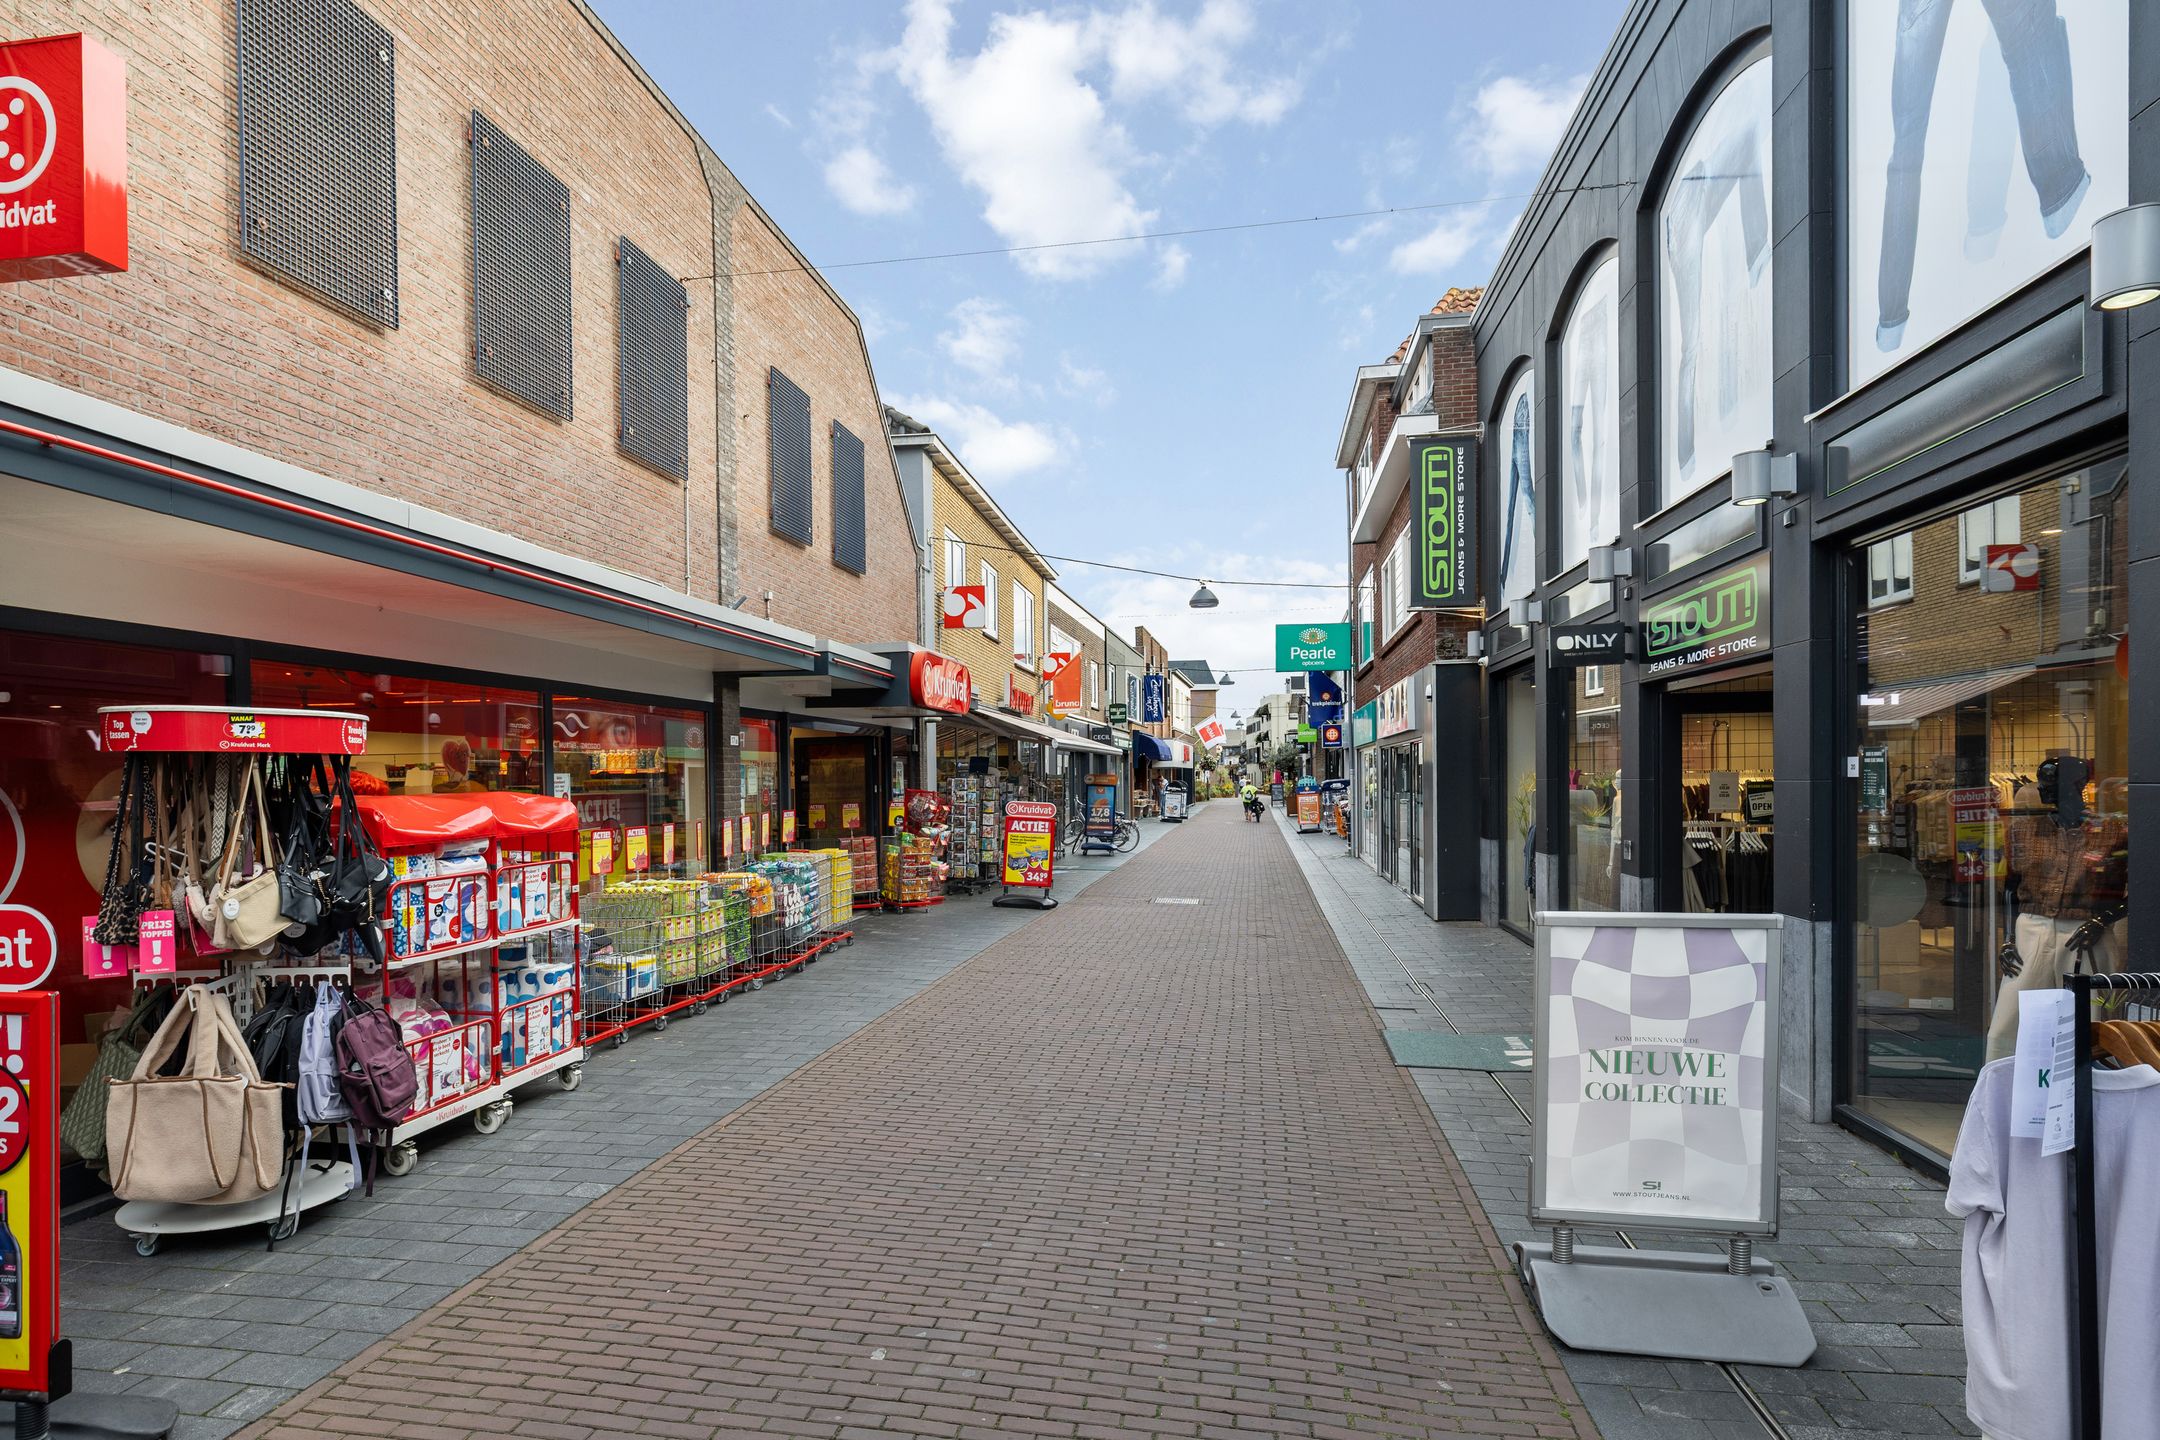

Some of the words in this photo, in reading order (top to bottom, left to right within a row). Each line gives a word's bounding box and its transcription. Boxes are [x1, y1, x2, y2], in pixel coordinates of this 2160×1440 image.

[0, 200, 57, 229] idvat
[1457, 446, 1465, 491] STORE
[1457, 495, 1465, 533] MORE
[1428, 454, 1449, 591] STOUT!
[1458, 537, 1465, 547] &
[1457, 551, 1465, 594] JEANS
[1651, 579, 1751, 647] STOUT!
[1556, 632, 1618, 650] ONLY
[1290, 646, 1336, 660] Pearle
[1648, 658, 1676, 674] JEANS
[1678, 655, 1685, 666] &
[1687, 646, 1716, 664] MORE
[1718, 635, 1757, 655] STORE
[934, 668, 968, 703] Kruidvat
[112, 720, 124, 730] Top
[109, 731, 130, 739] tassen
[576, 799, 620, 823] ACTIE!
[1018, 805, 1052, 815] Kruidvat
[1090, 808, 1110, 817] 17,8
[1752, 802, 1772, 811] OPEN
[627, 828, 646, 837] ACTIE!
[1011, 820, 1049, 832] ACTIE!
[593, 830, 611, 840] ACTIE!
[141, 920, 173, 930] PRIJS
[141, 929, 173, 938] TOPPER
[1588, 1049, 1726, 1078] NIEUWE
[1584, 1081, 1727, 1106] COLLECTIE
[1612, 1191, 1692, 1201] WWW.STOUTJEANS.NL
